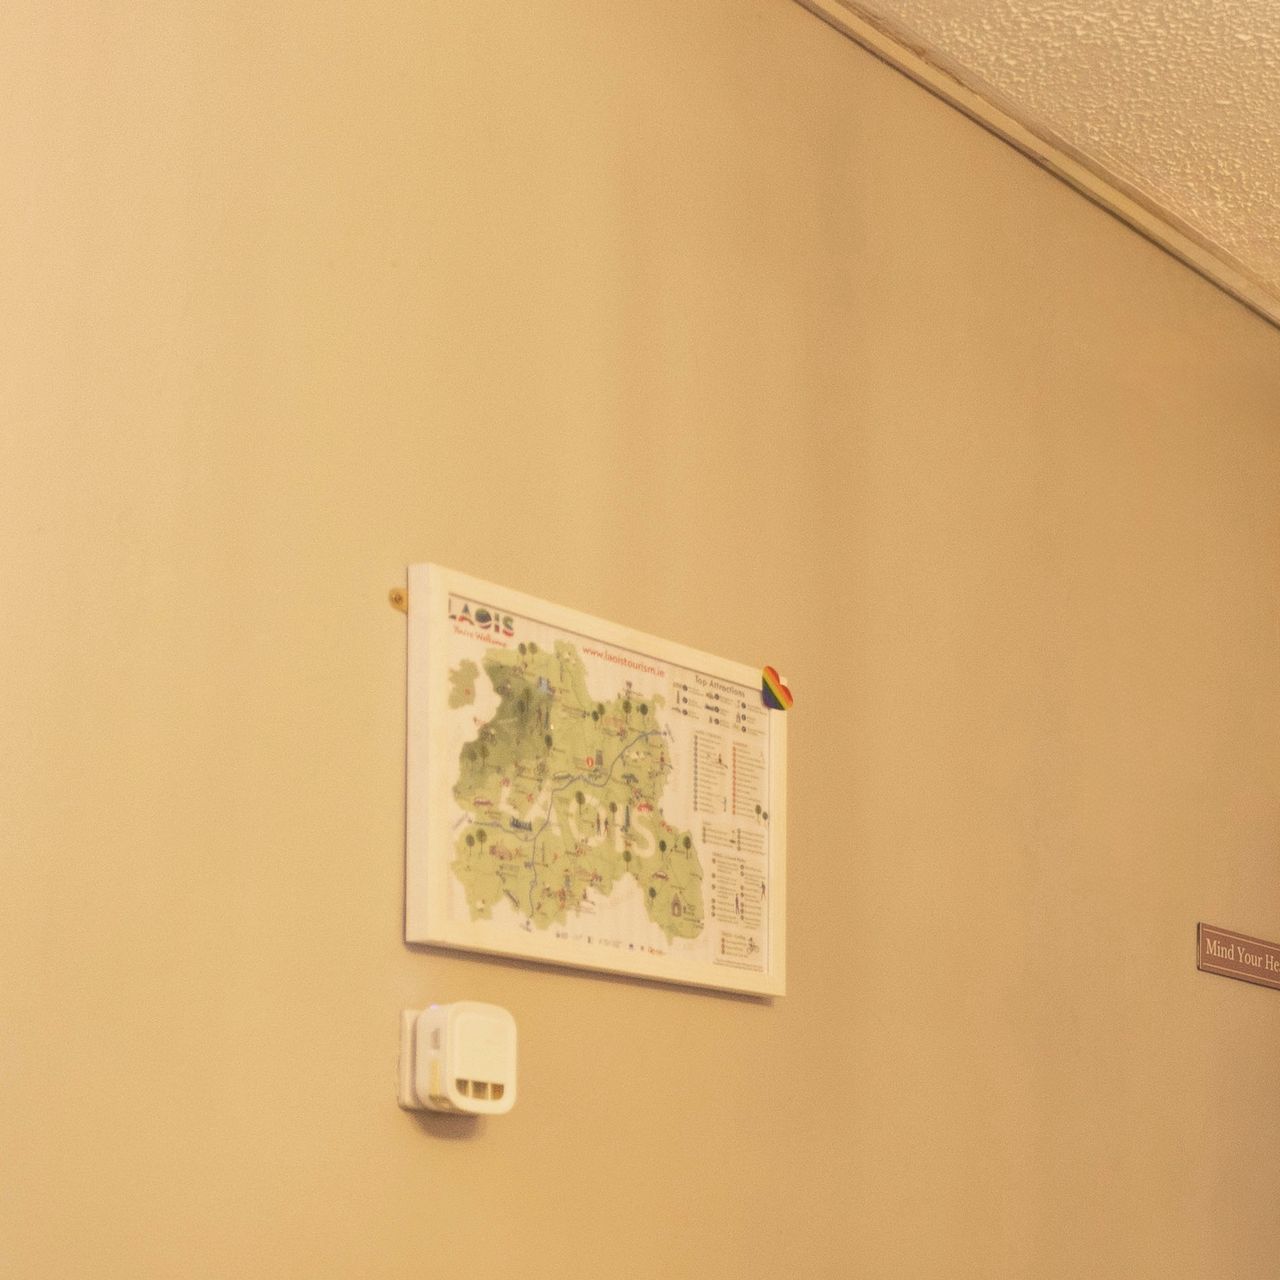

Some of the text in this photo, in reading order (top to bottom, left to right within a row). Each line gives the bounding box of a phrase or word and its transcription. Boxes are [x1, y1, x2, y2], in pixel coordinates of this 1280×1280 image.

[448, 597, 514, 637] LAOIS
[582, 646, 666, 678] www.laoistourism.ie
[695, 675, 746, 698] Top Attractions
[1205, 937, 1235, 960] Mind
[1237, 946, 1263, 968] Your
